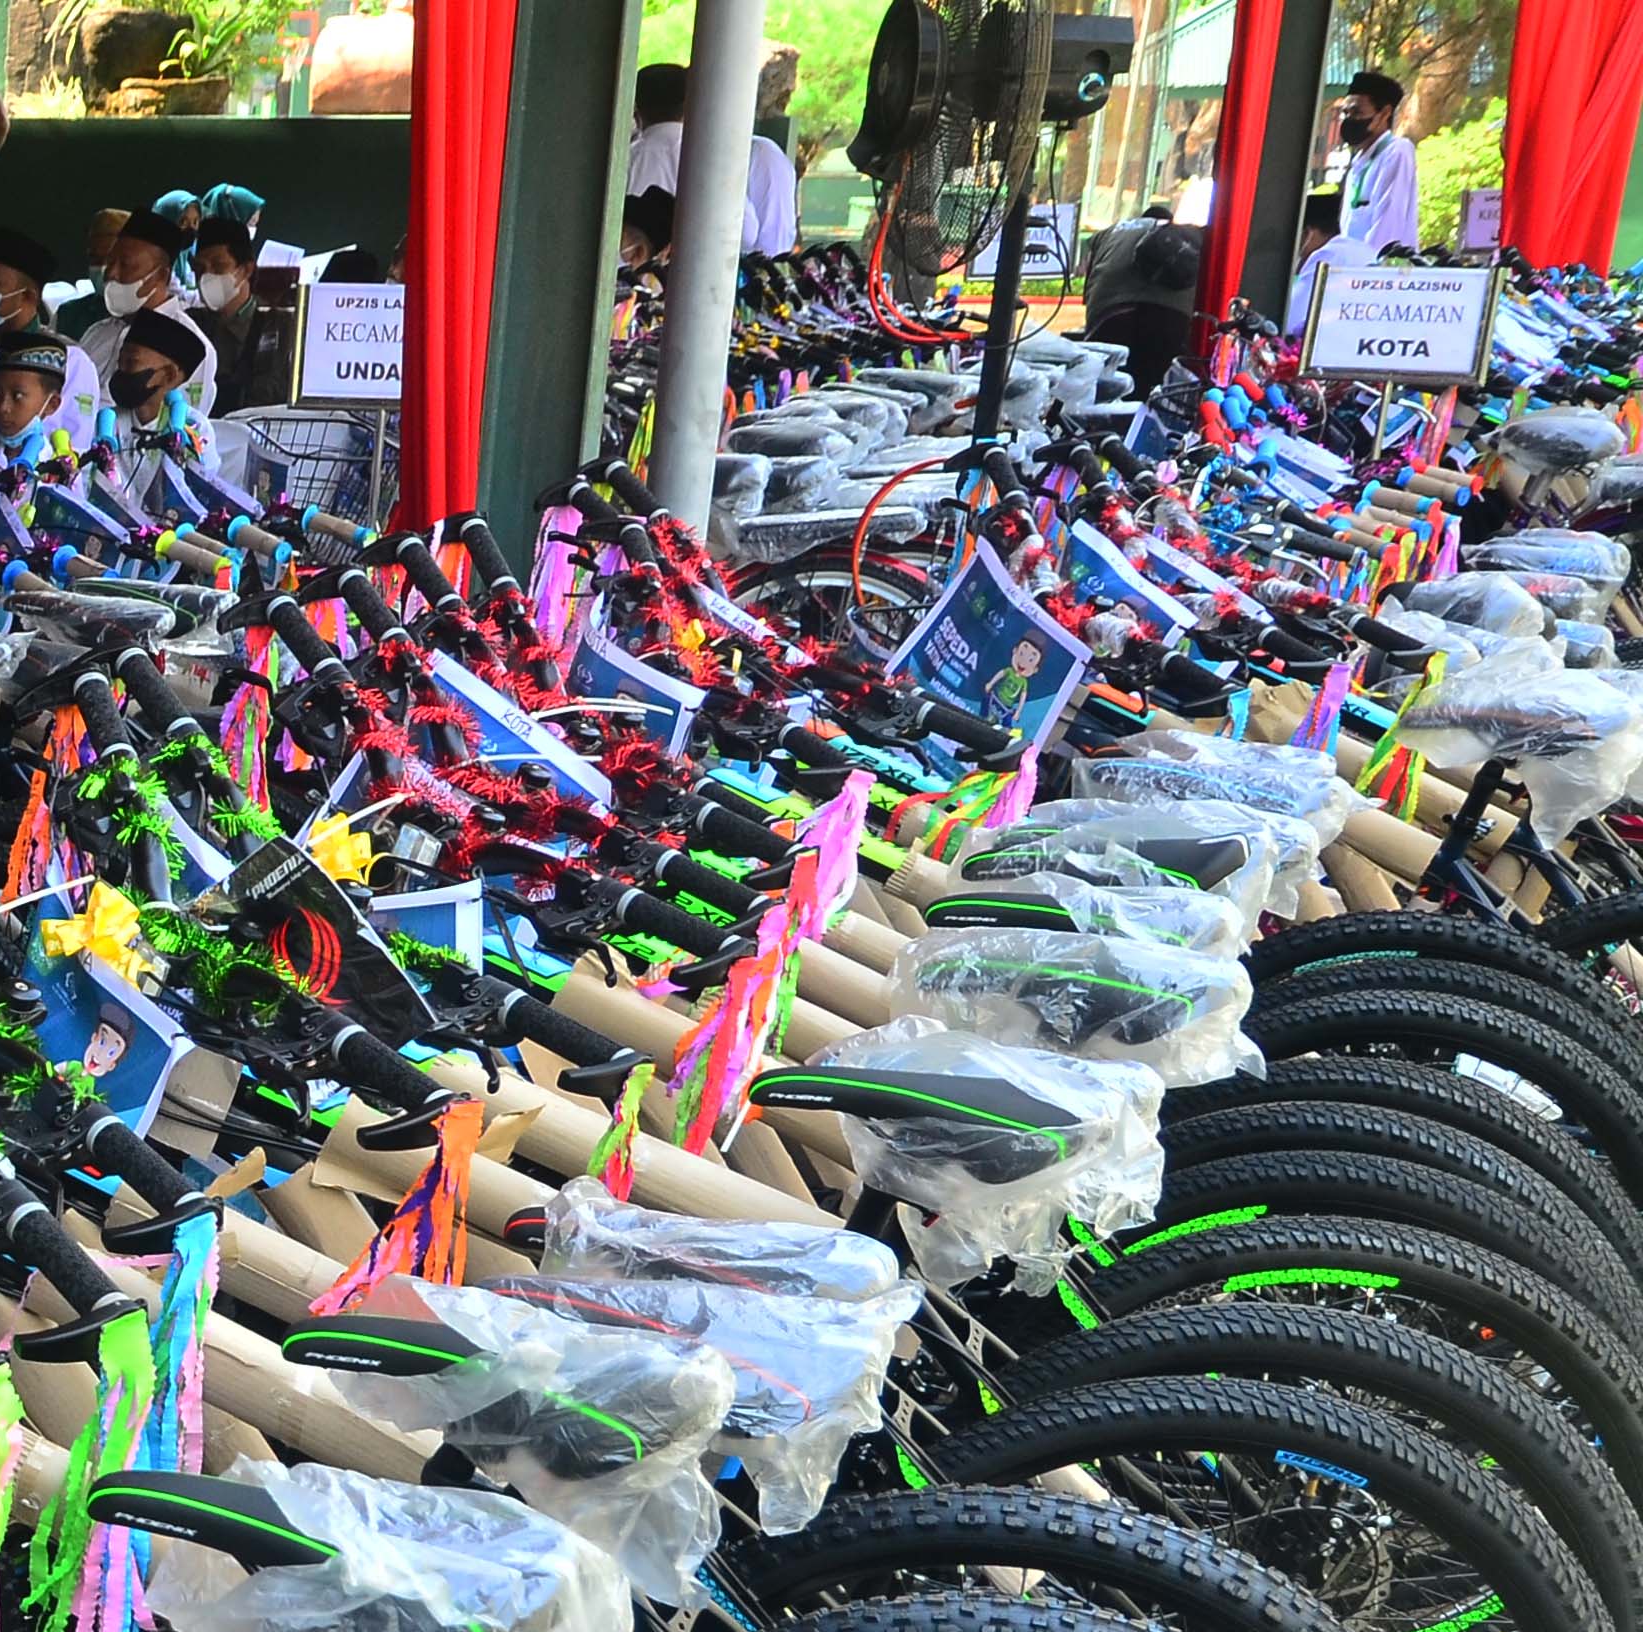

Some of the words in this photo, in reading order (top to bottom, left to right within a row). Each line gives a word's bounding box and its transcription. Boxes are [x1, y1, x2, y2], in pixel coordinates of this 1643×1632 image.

[1351, 279, 1394, 291] UPZIS
[1398, 280, 1463, 293] LAZISNU
[335, 297, 379, 309] UPZIS
[1339, 302, 1465, 324] KECAMATAN
[325, 322, 402, 344] KECAM
[1356, 338, 1431, 358] KOTA
[939, 615, 979, 671] SEPEDA
[501, 708, 533, 742] KOTA
[839, 744, 880, 768] 172
[884, 765, 917, 786] XR
[246, 850, 305, 900] PHOENIX
[304, 1352, 381, 1367] PHOENIX
[114, 1512, 197, 1536] PHOENIX
